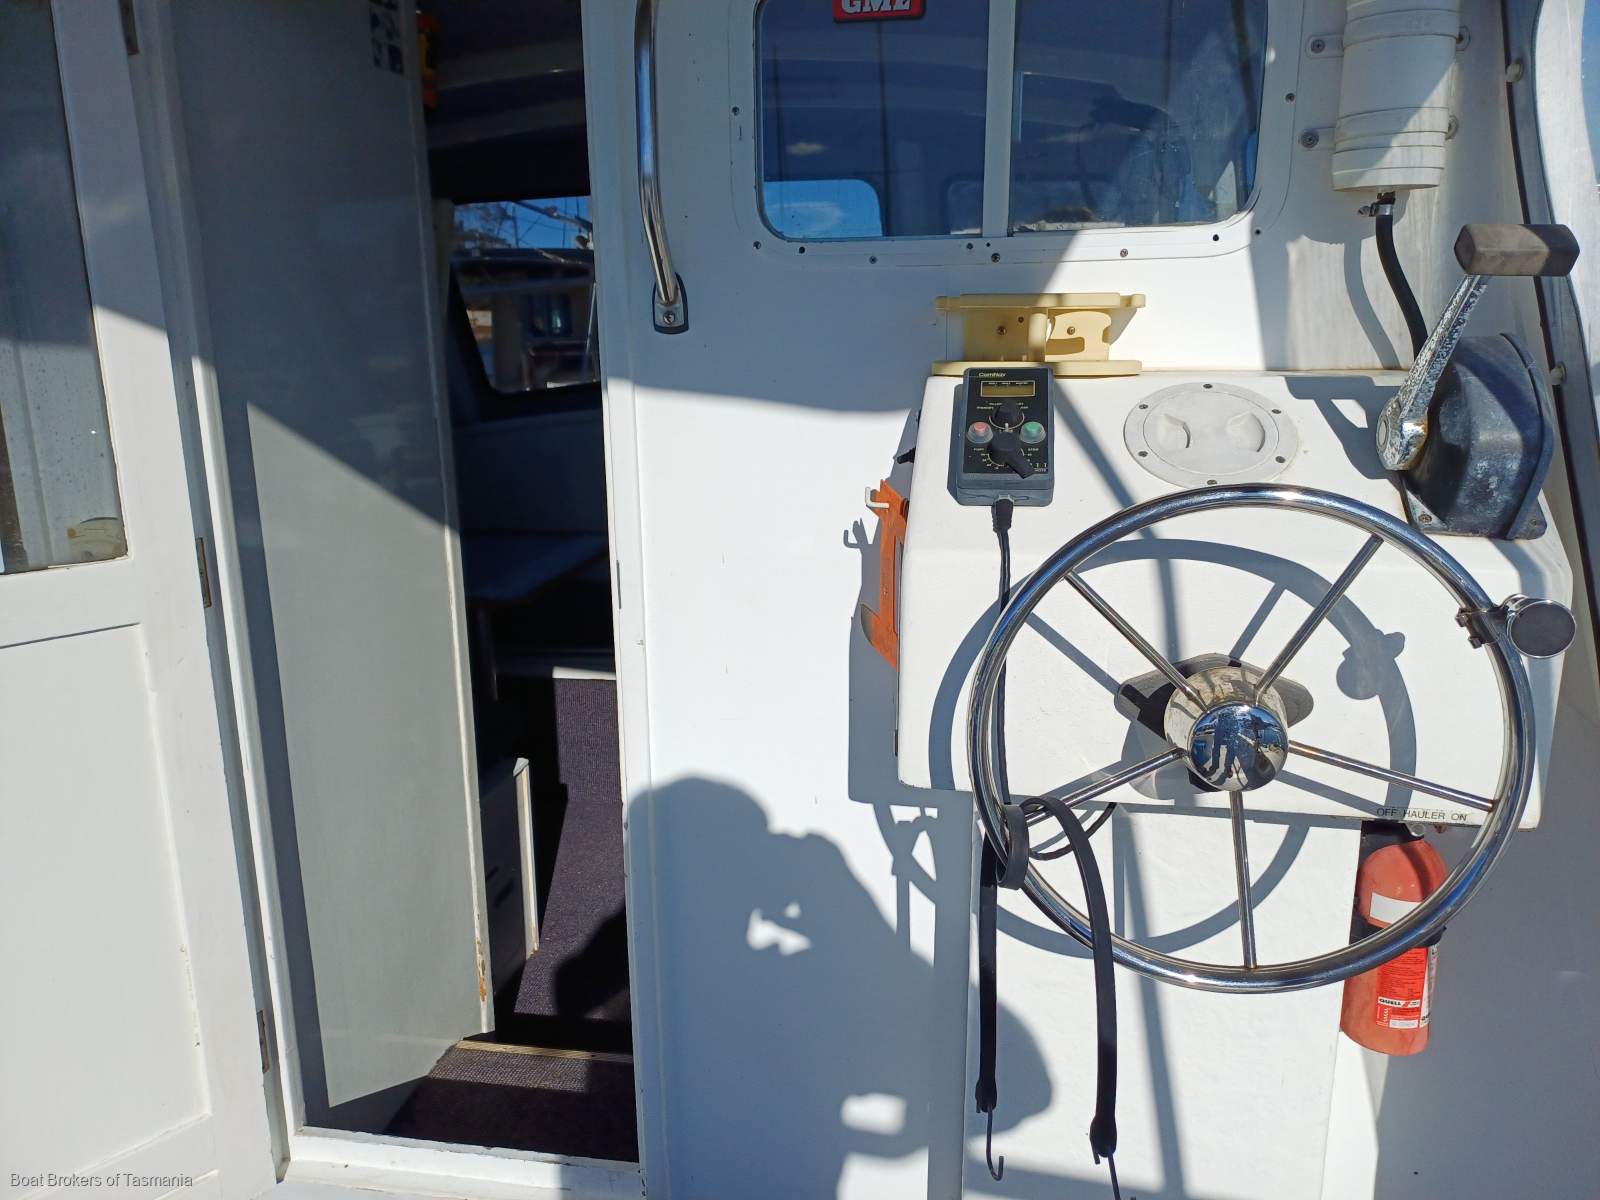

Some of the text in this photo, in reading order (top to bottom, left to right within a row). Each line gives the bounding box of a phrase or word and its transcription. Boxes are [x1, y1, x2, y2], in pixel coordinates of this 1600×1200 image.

[1376, 807, 1468, 821] OFF HAULER ON
